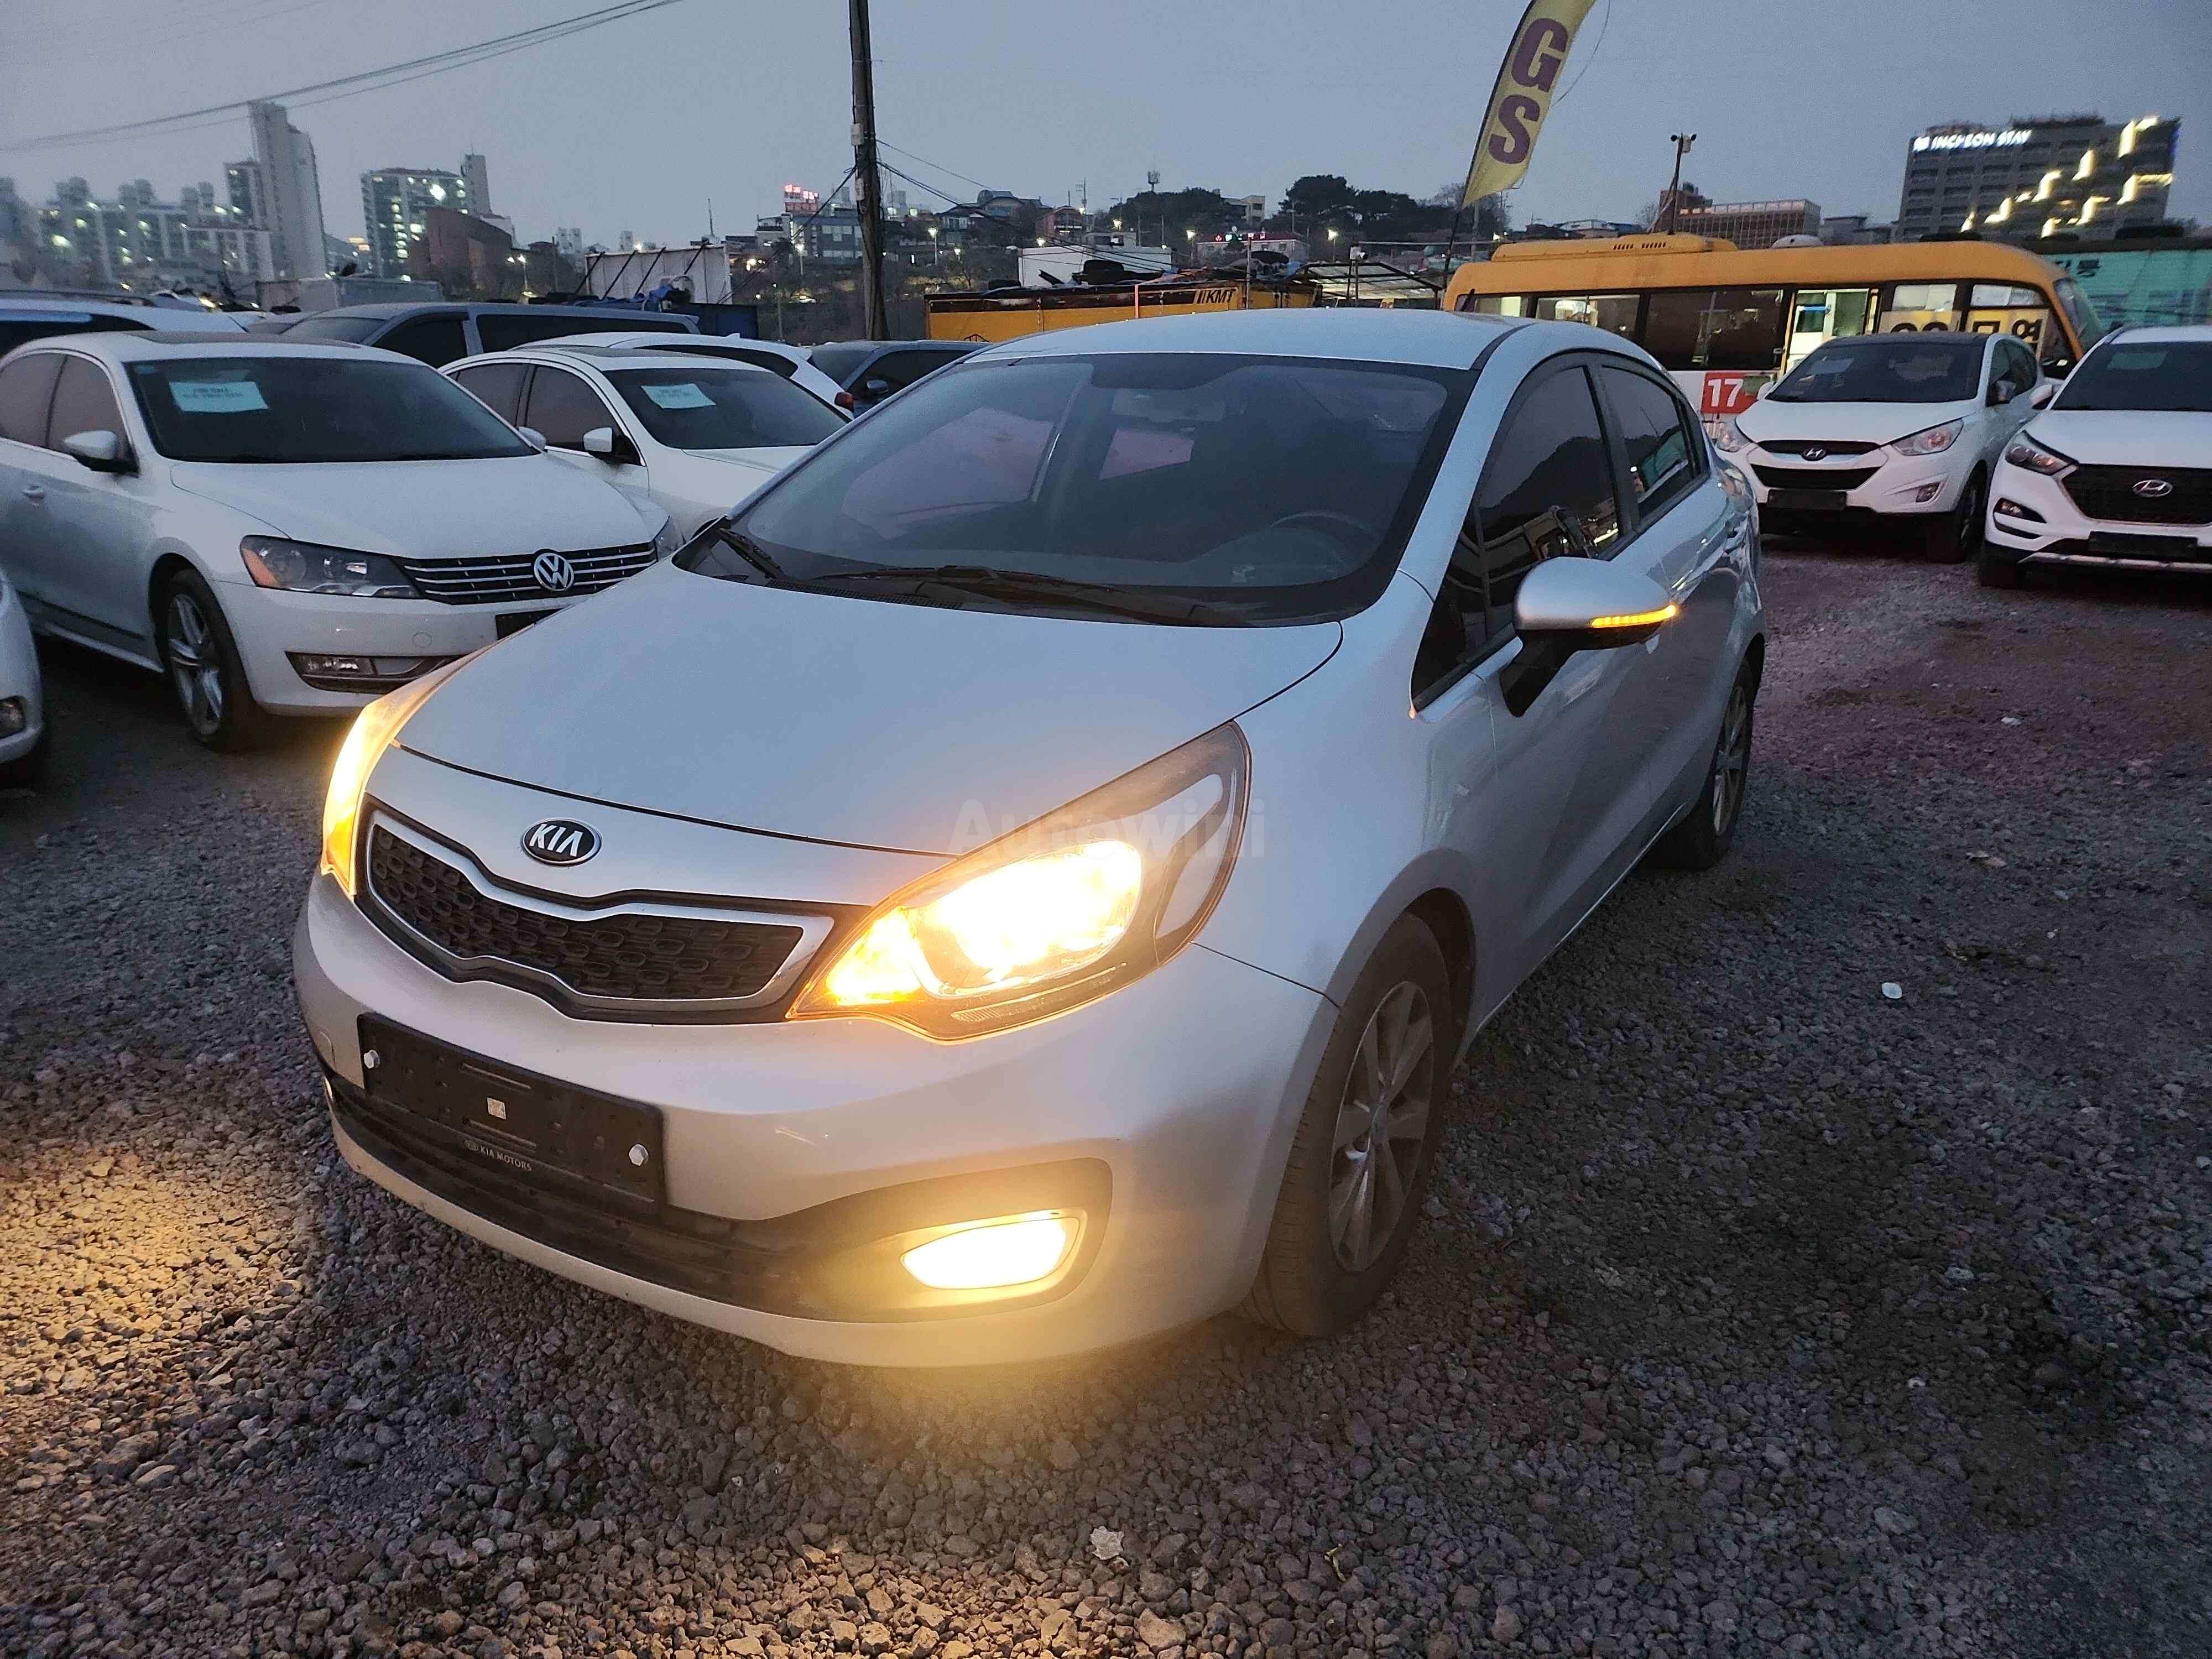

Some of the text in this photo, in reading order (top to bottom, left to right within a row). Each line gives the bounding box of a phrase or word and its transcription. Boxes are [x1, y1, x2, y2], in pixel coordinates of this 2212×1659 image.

[1997, 129, 2032, 147] STAY
[1708, 378, 1744, 407] 17
[529, 823, 583, 857] KIA
[481, 1145, 495, 1159] KIA
[496, 1151, 531, 1172] MOTORS
